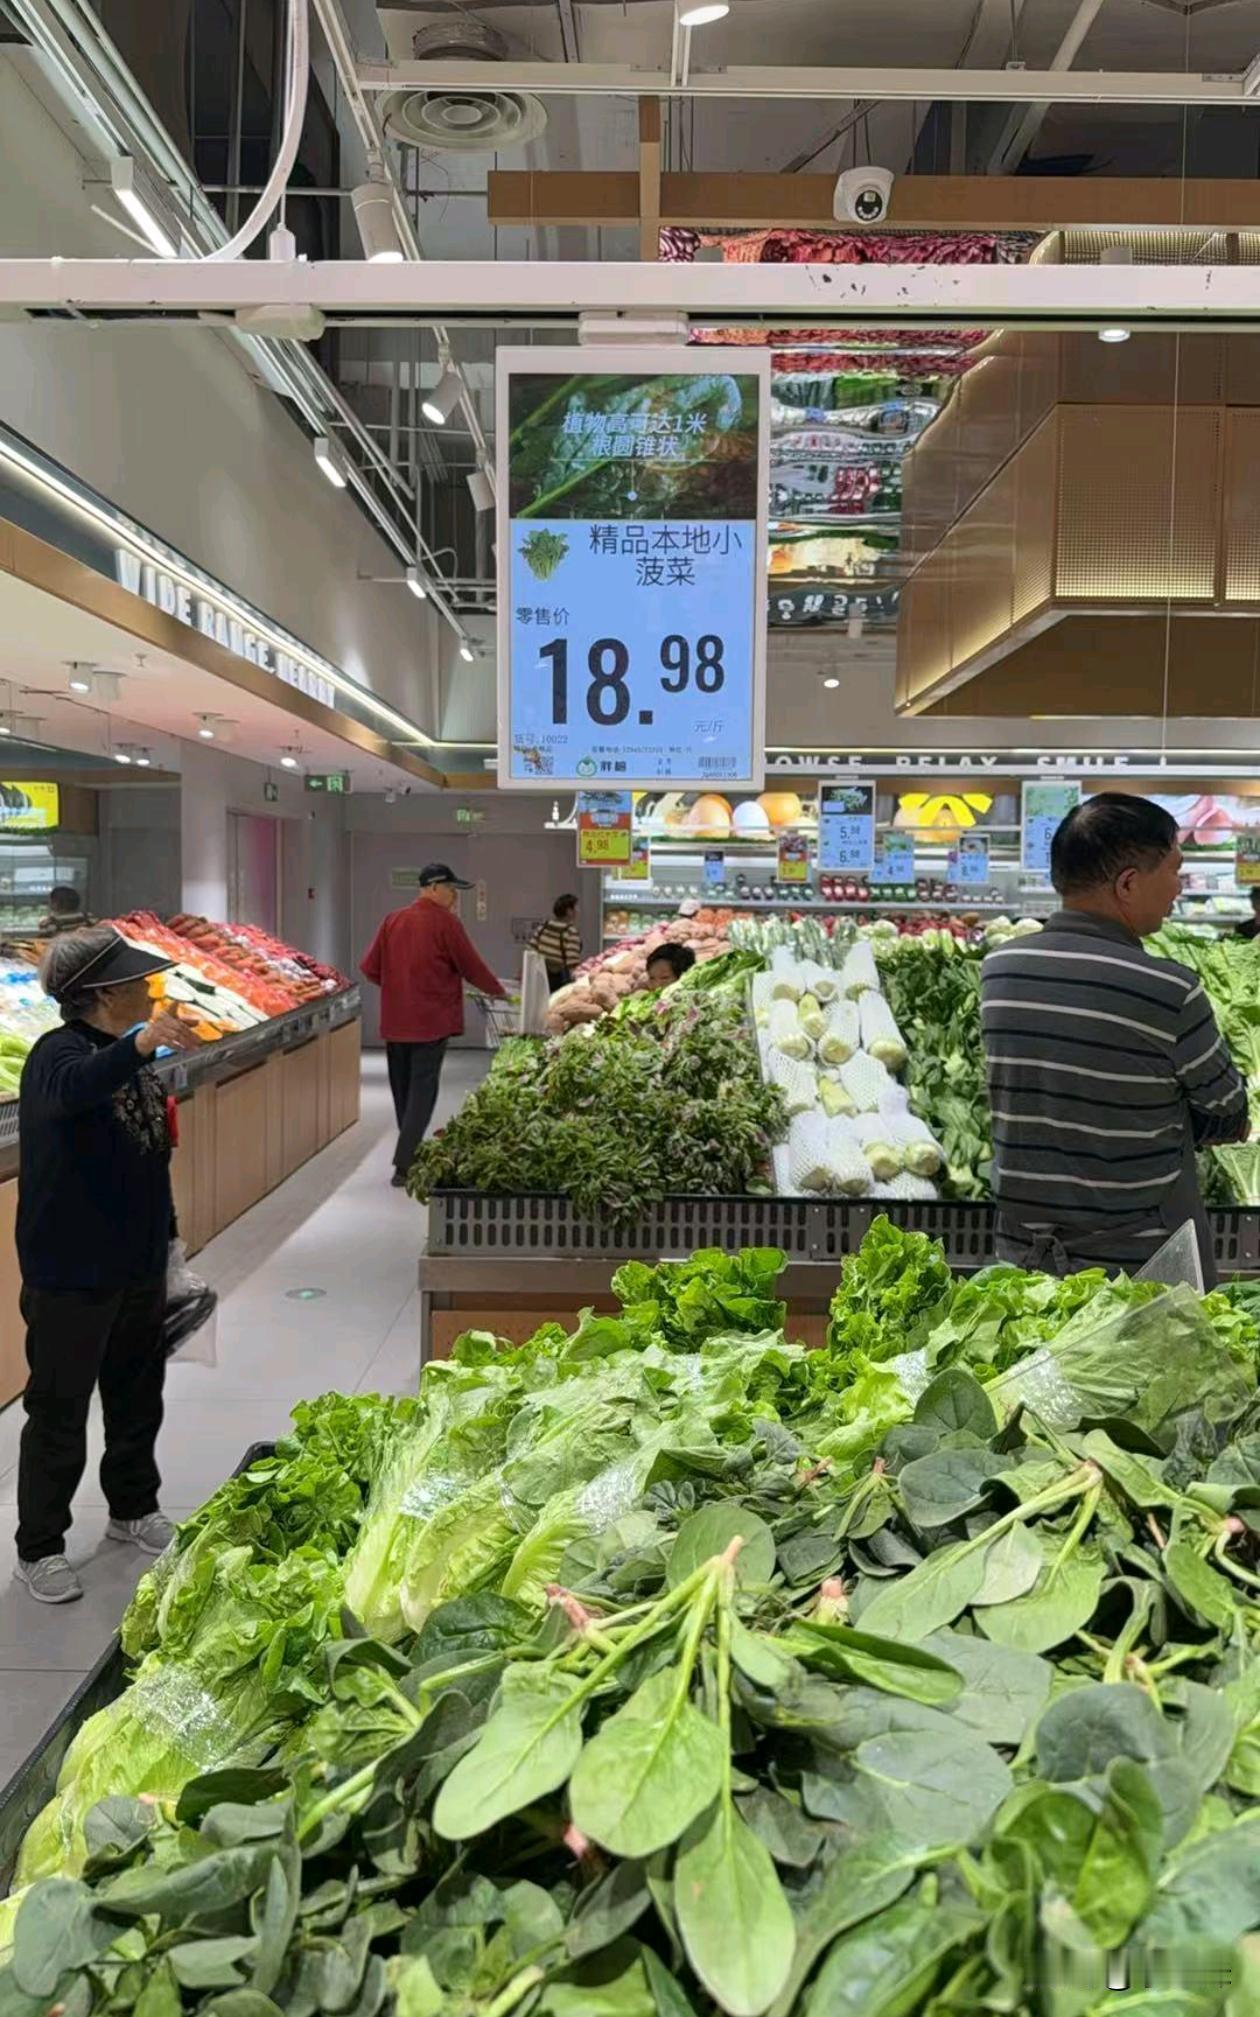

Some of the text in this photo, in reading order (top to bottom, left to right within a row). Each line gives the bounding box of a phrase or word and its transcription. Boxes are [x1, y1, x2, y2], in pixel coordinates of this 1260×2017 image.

[589, 524, 743, 555] 精品本地小
[636, 556, 696, 586] 菠菜
[115, 548, 192, 627] WIDE
[516, 606, 570, 626] 零售价
[694, 719, 724, 734] 元/斤
